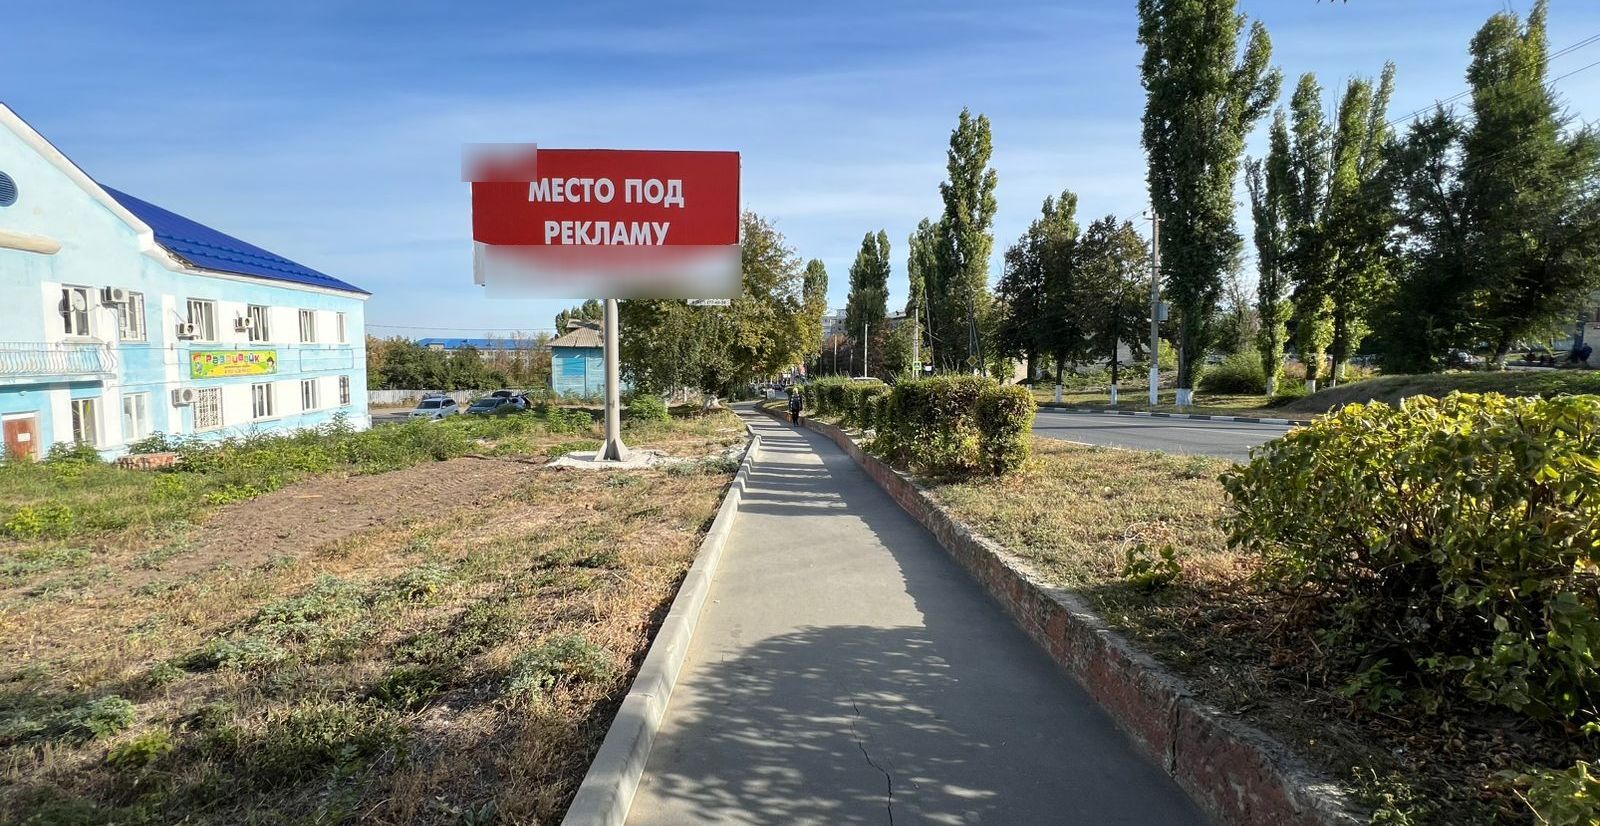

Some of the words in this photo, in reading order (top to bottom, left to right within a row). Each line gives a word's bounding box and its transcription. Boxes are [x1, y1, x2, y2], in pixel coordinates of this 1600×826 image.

[528, 177, 615, 204] МЕСТО
[625, 178, 685, 208] ПОД
[544, 221, 670, 246] РЕКЛАМУ
